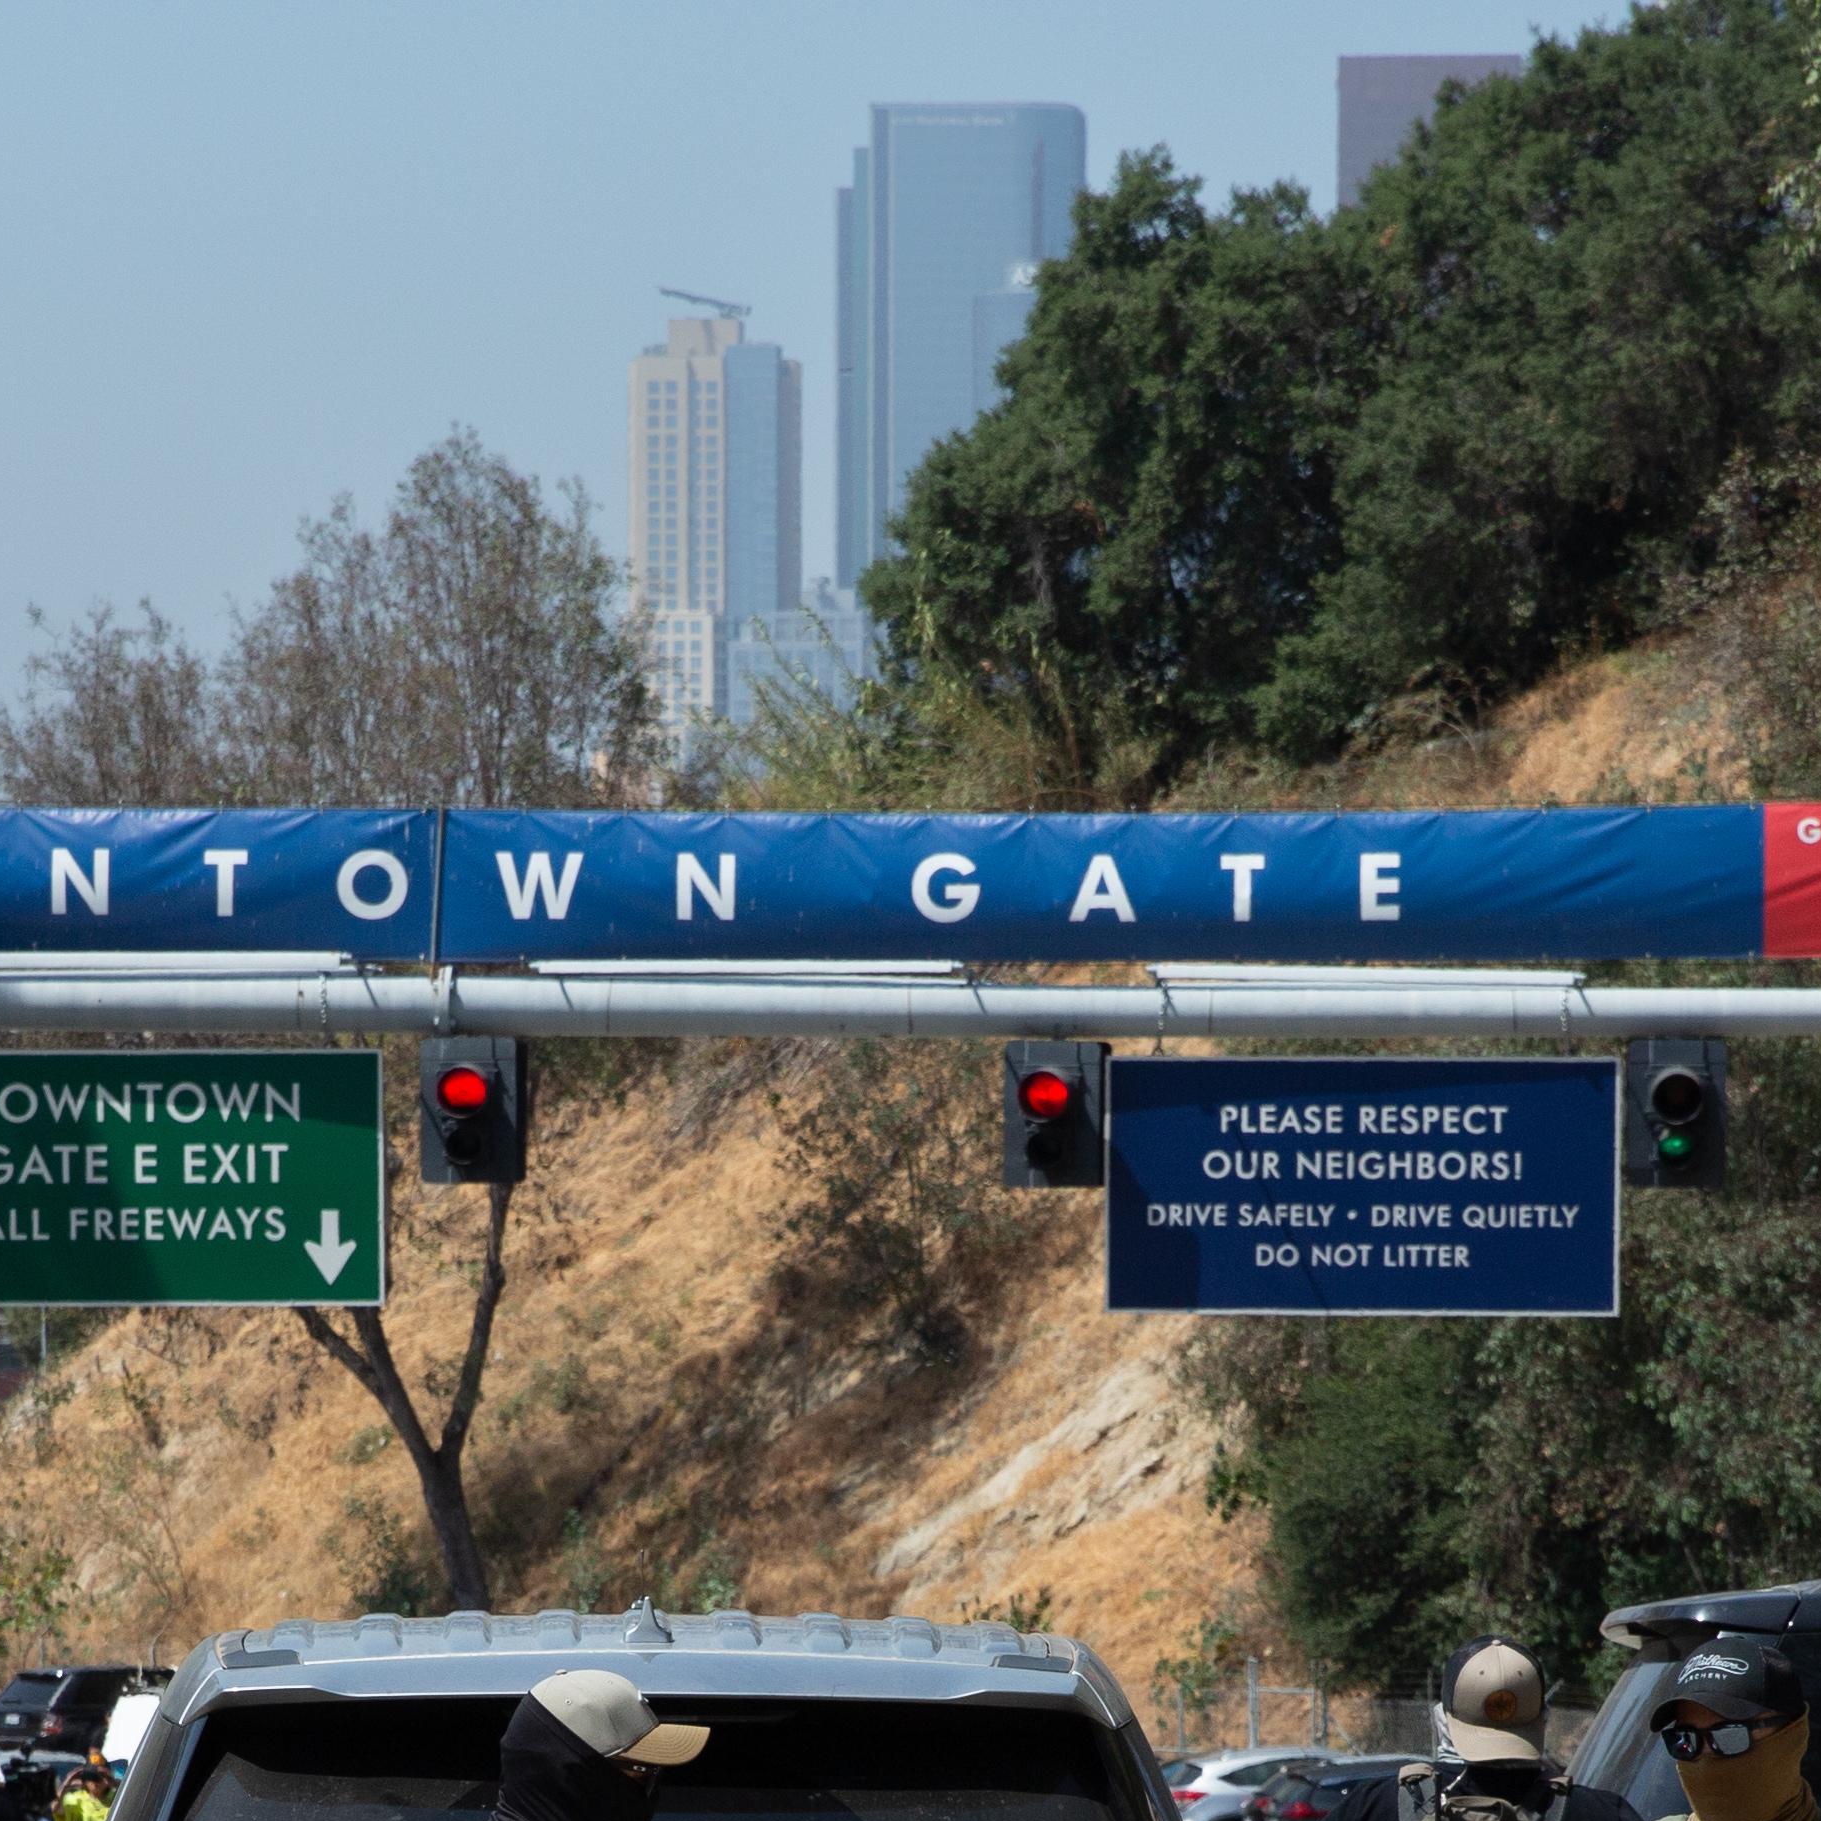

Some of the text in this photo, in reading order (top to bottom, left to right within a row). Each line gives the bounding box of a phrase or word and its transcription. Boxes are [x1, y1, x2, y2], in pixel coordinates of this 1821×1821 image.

[910, 850, 1402, 924] GATE
[1219, 1104, 1508, 1135] PLEASE RESPECT
[134, 1143, 158, 1185] E
[182, 1143, 288, 1185] EXIT
[1202, 1149, 1524, 1182] OUR NEIGHBORS!
[69, 1206, 287, 1243] FREEWAYS
[1147, 1202, 1580, 1231] DRIVE SAFELY DRIVE QUIETLY
[1255, 1243, 1471, 1269] DO NOT LITTER
